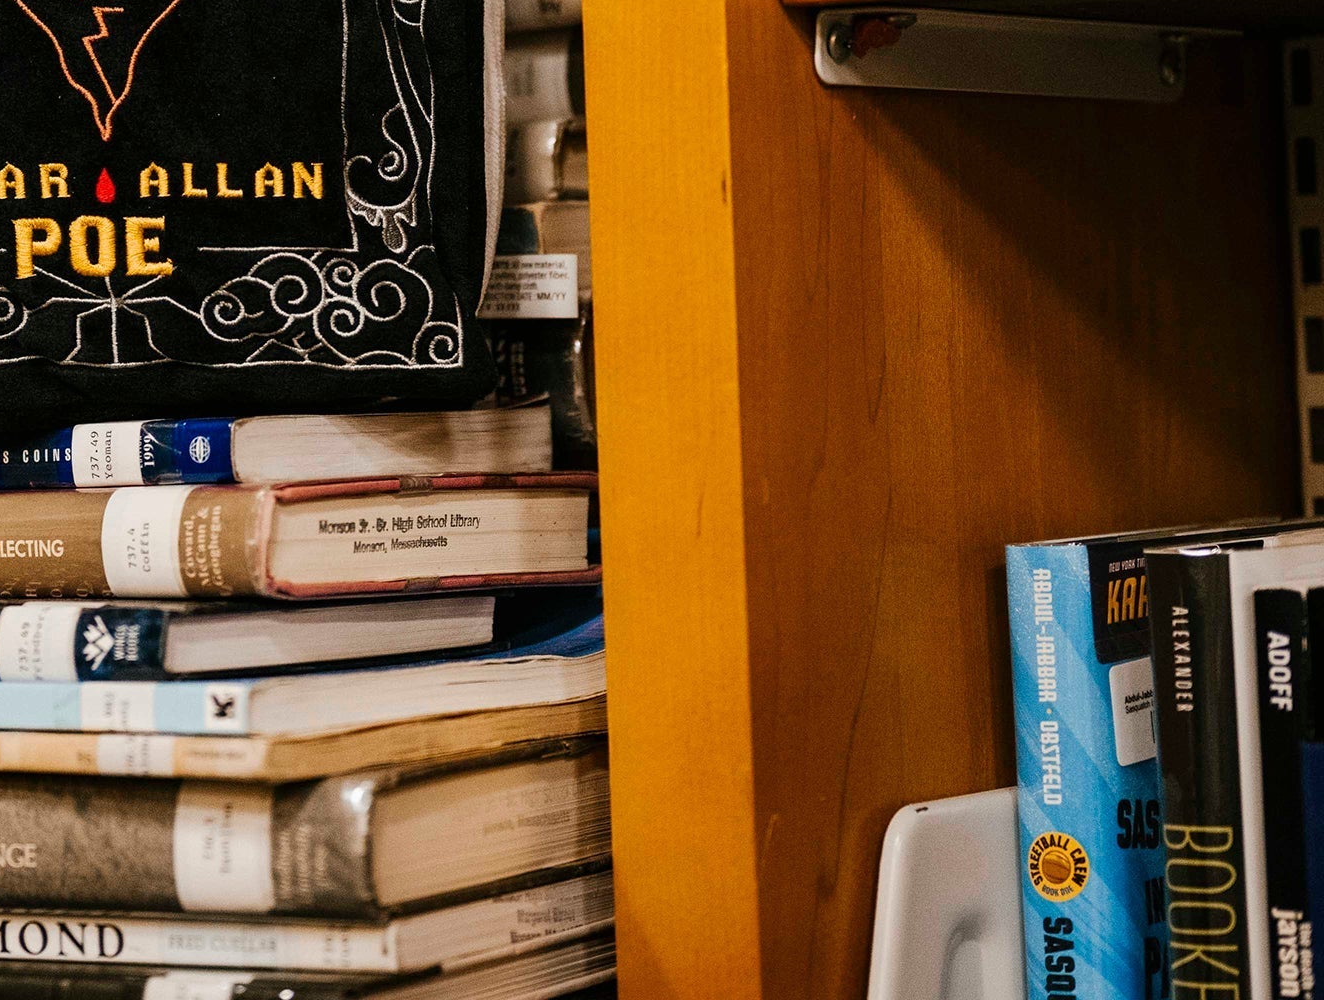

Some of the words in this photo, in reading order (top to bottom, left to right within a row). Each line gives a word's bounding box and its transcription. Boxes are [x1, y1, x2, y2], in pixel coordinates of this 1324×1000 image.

[139, 161, 324, 200] ALLAN
[13, 215, 173, 279] POE
[22, 448, 72, 463] COINS
[90, 431, 100, 479] 737.49
[105, 430, 113, 480] Yeoman
[143, 435, 155, 467] 1999
[127, 528, 137, 568] 737.4
[141, 522, 151, 572] Coffin
[184, 515, 197, 579] Coward,
[318, 520, 356, 534] Monson
[392, 516, 413, 533] High
[416, 514, 447, 530] School
[450, 514, 480, 529] Library
[353, 541, 387, 553] Monson,
[1108, 561, 1120, 573] NEW
[1121, 560, 1136, 571] YORK
[114, 624, 126, 661] WINGS
[127, 624, 140, 662] BOOKS
[1033, 568, 1057, 703] ABDUL-JABBAR
[1172, 606, 1194, 712] ALEXANDER
[1267, 631, 1293, 713] ADOFF
[1039, 720, 1062, 805] OBSTFELD
[1029, 834, 1070, 887] STREETBALL
[1069, 847, 1087, 888] CREW
[1042, 884, 1059, 897] BOOK
[1060, 884, 1074, 896] ONE
[1043, 916, 1076, 1000] SASQ
